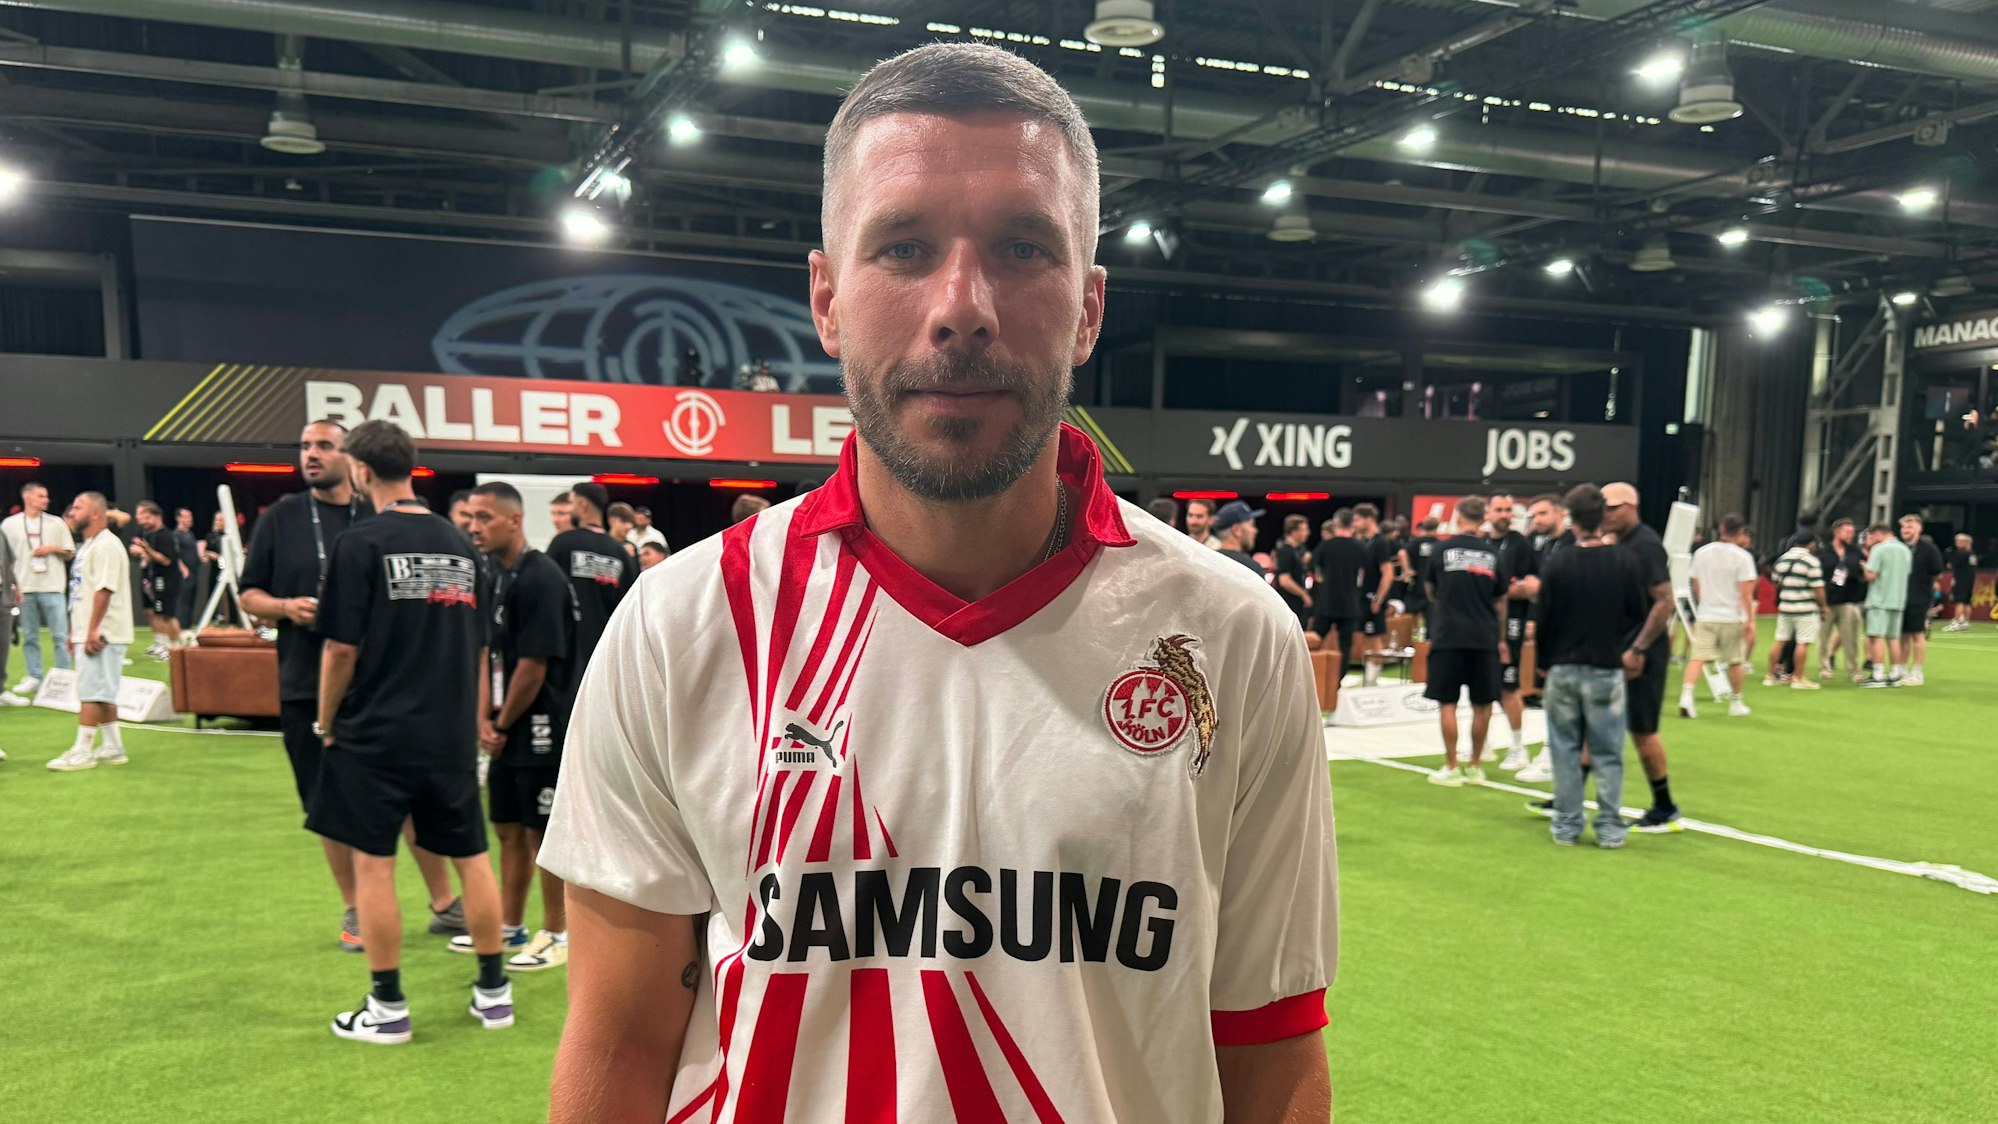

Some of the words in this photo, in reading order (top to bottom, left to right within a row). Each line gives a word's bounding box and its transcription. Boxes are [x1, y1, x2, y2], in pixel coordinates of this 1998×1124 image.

[305, 381, 622, 447] BALLER
[1254, 424, 1351, 468] XING
[1482, 428, 1575, 477] JOBS
[776, 751, 815, 763] PUMA
[1121, 720, 1166, 743] KÖLN
[747, 865, 1178, 972] SAMSUNG
